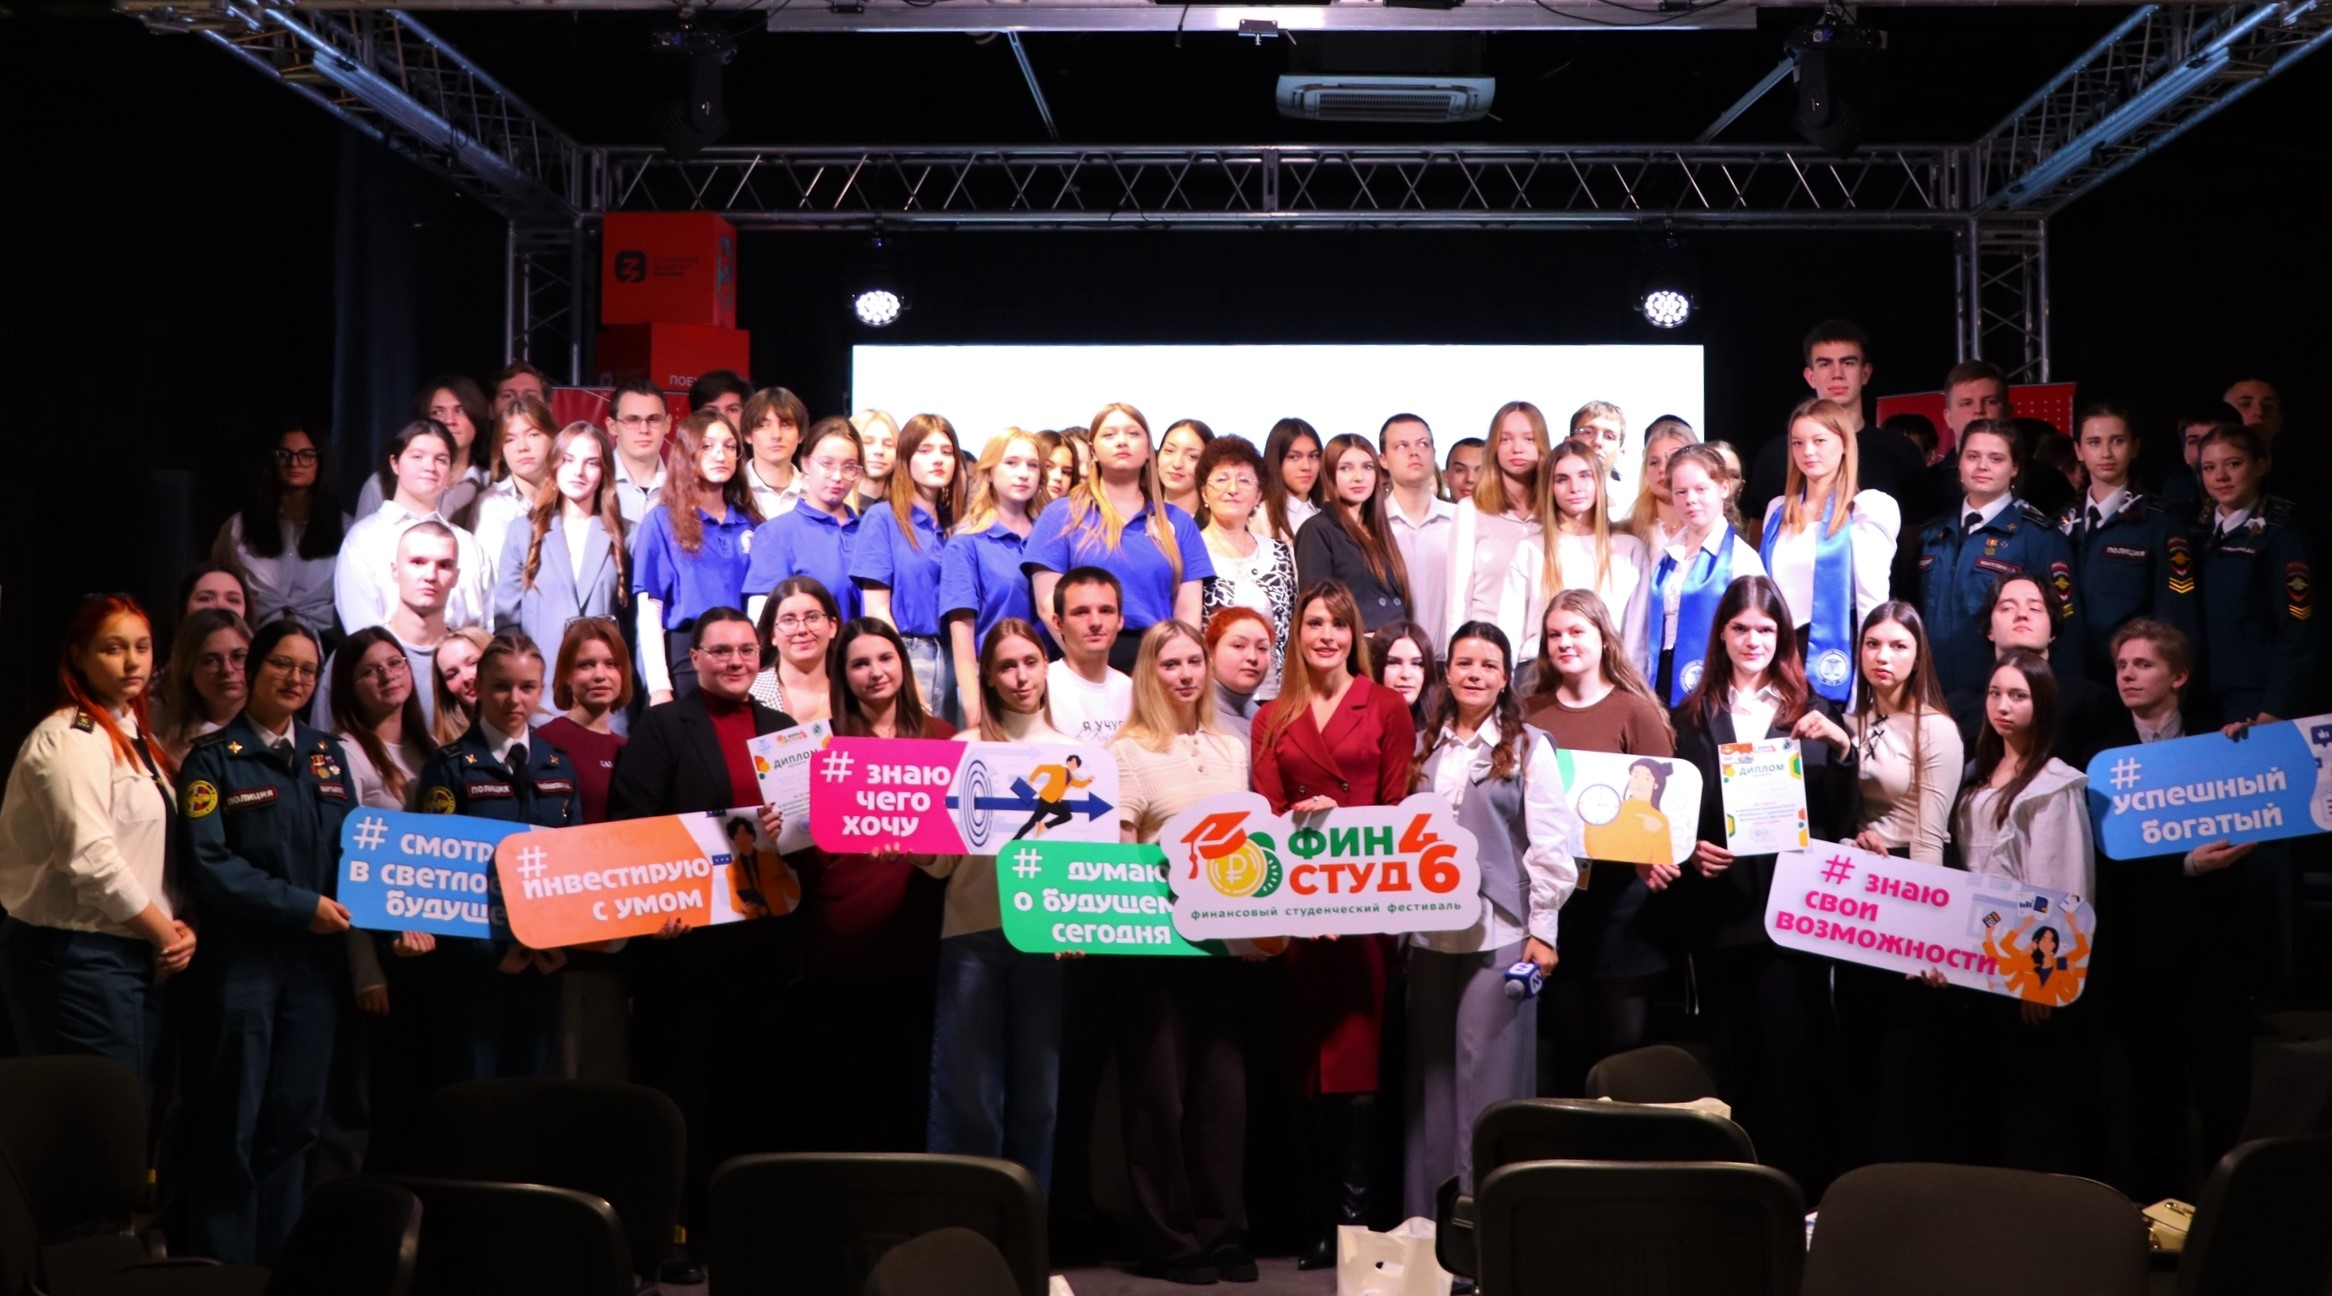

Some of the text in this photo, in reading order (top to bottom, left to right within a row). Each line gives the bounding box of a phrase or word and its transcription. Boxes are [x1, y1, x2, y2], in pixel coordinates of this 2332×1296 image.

[669, 374, 698, 387] ПОЕ
[1083, 721, 1092, 731] Я
[867, 764, 951, 786] знаю
[1739, 763, 1784, 776] ДИПЛОМ
[228, 789, 274, 806] ПОЛИЦИЯ
[471, 785, 511, 794] ПОЛИЦИЯ
[2112, 766, 2287, 815] успешный
[856, 791, 931, 812] чего
[842, 815, 919, 837] хочу
[2142, 802, 2283, 844] богатый
[400, 833, 496, 863] смотр
[1288, 825, 1394, 860] ФИН
[350, 860, 370, 882] в
[522, 857, 711, 900] инвестирую
[1289, 861, 1412, 895] СТУД
[1014, 891, 1033, 911] о
[1865, 873, 1950, 908] знаю
[386, 889, 507, 925] будуще
[592, 889, 704, 920] с умом
[1191, 902, 1462, 921] финансовый студенческий фестиваль
[1805, 890, 1879, 922] свои
[1052, 923, 1172, 944] сегодня
[1775, 911, 1998, 975] возможности
